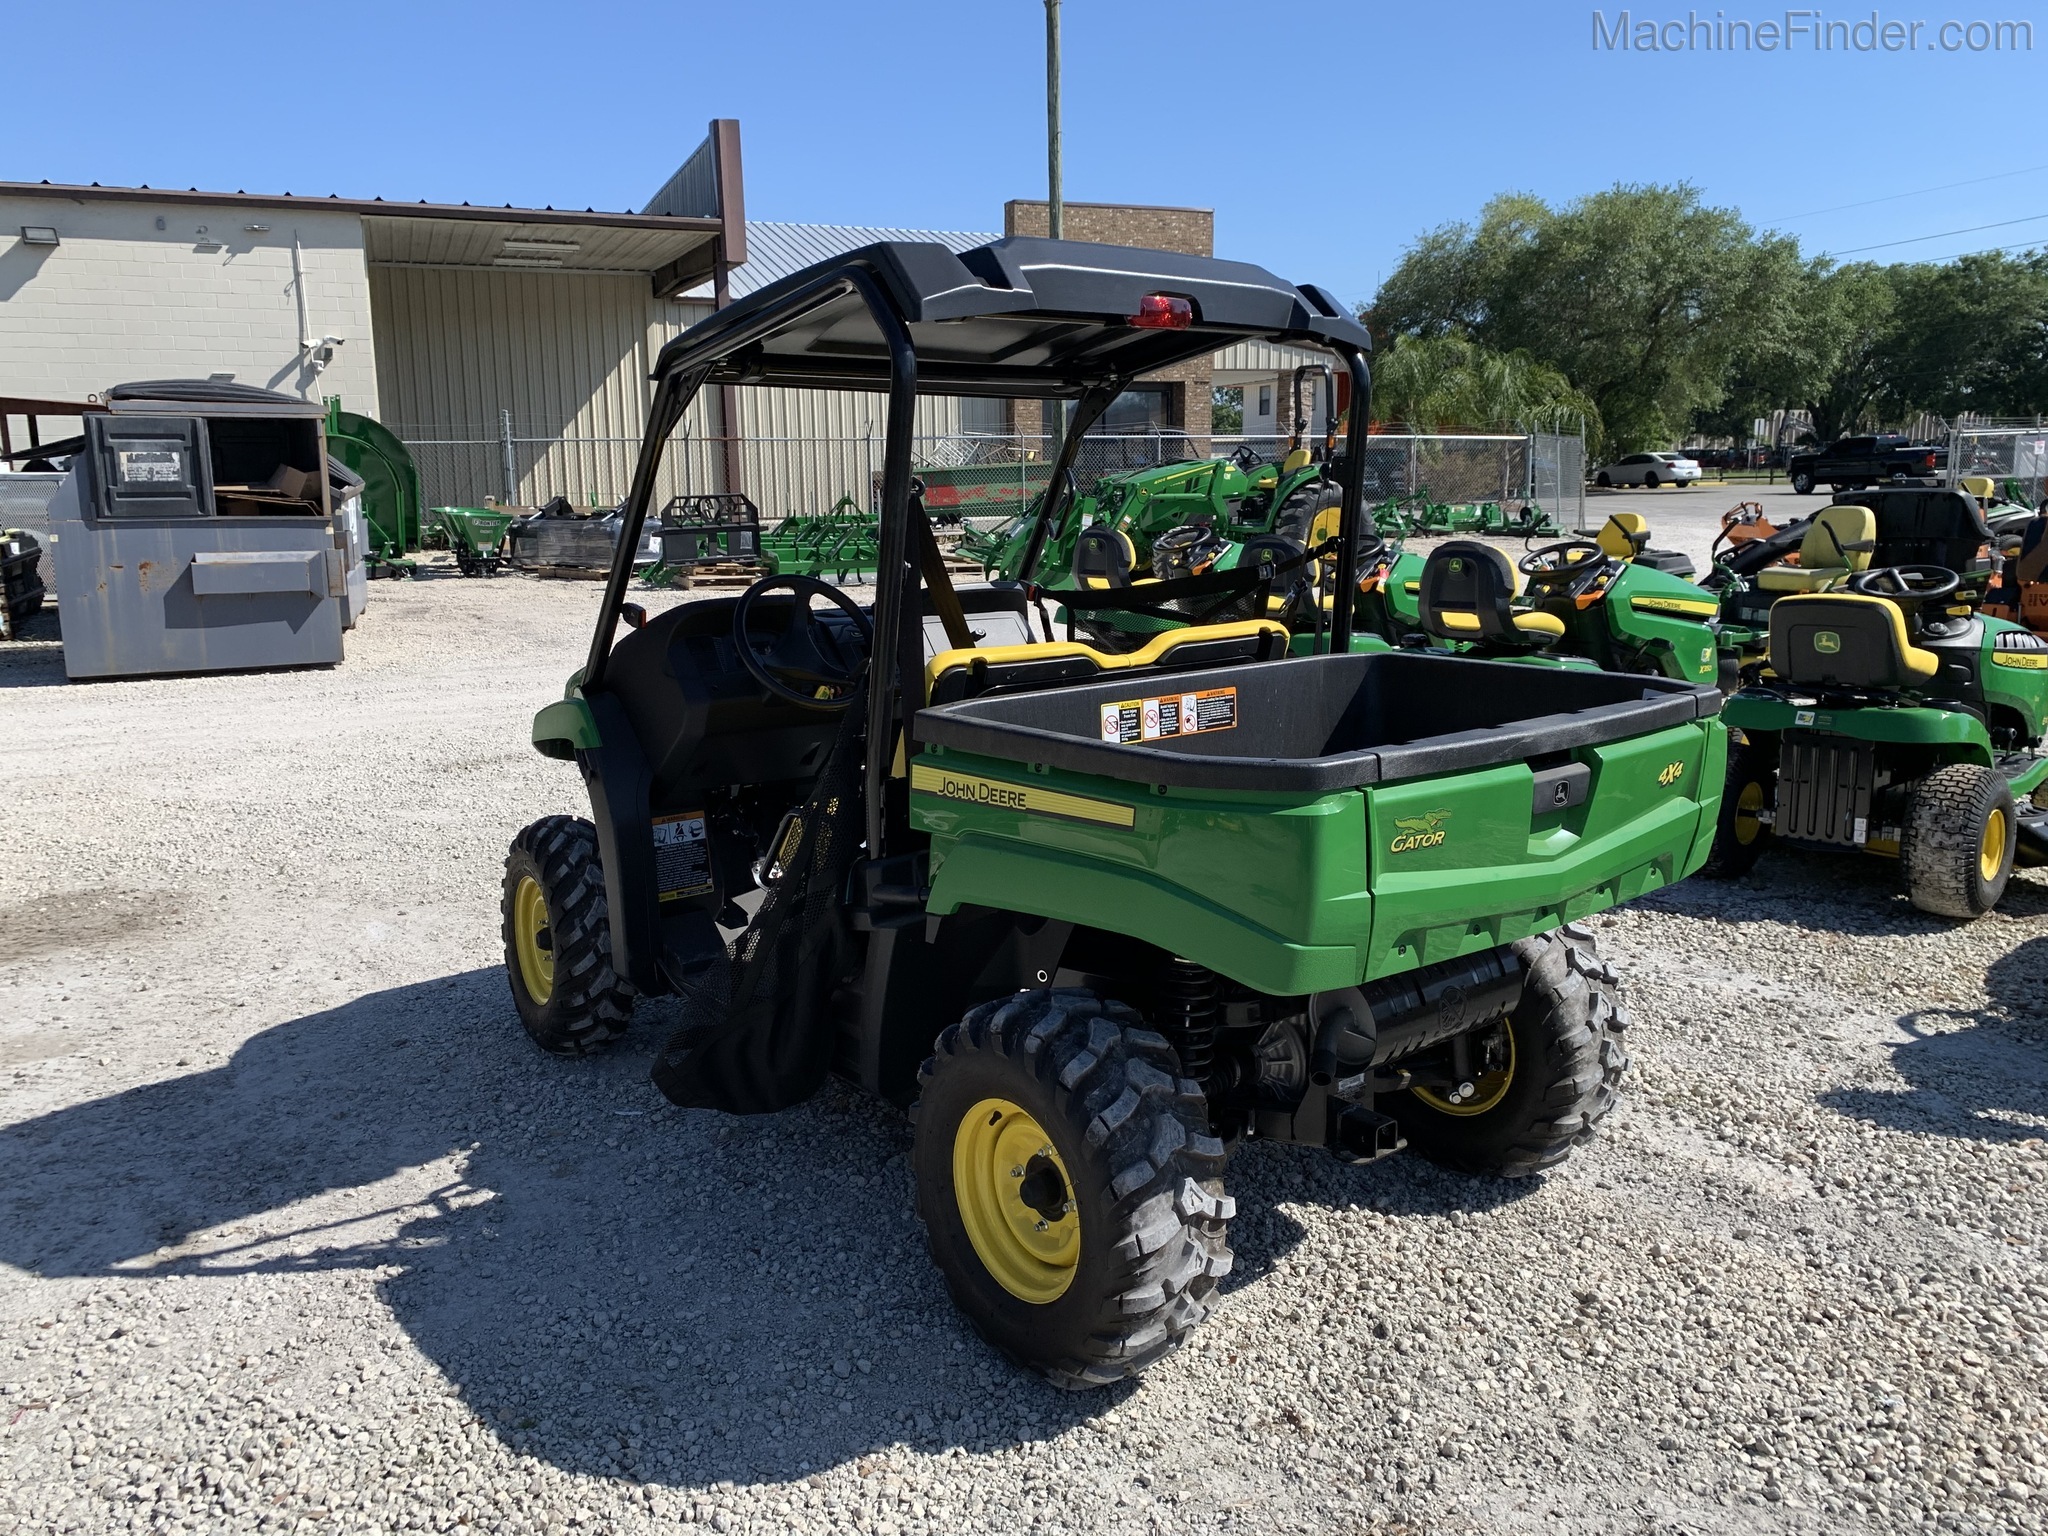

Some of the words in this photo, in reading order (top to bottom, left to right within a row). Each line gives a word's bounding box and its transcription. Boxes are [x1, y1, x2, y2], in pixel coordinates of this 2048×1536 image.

[1648, 599, 1663, 607] JOHN
[1664, 600, 1681, 609] DEERE
[2003, 655, 2021, 666] JOHN
[2022, 656, 2038, 667] DEERE
[938, 777, 976, 799] JOHN
[979, 783, 1027, 808] DEERE
[1390, 830, 1446, 853] GATOR
